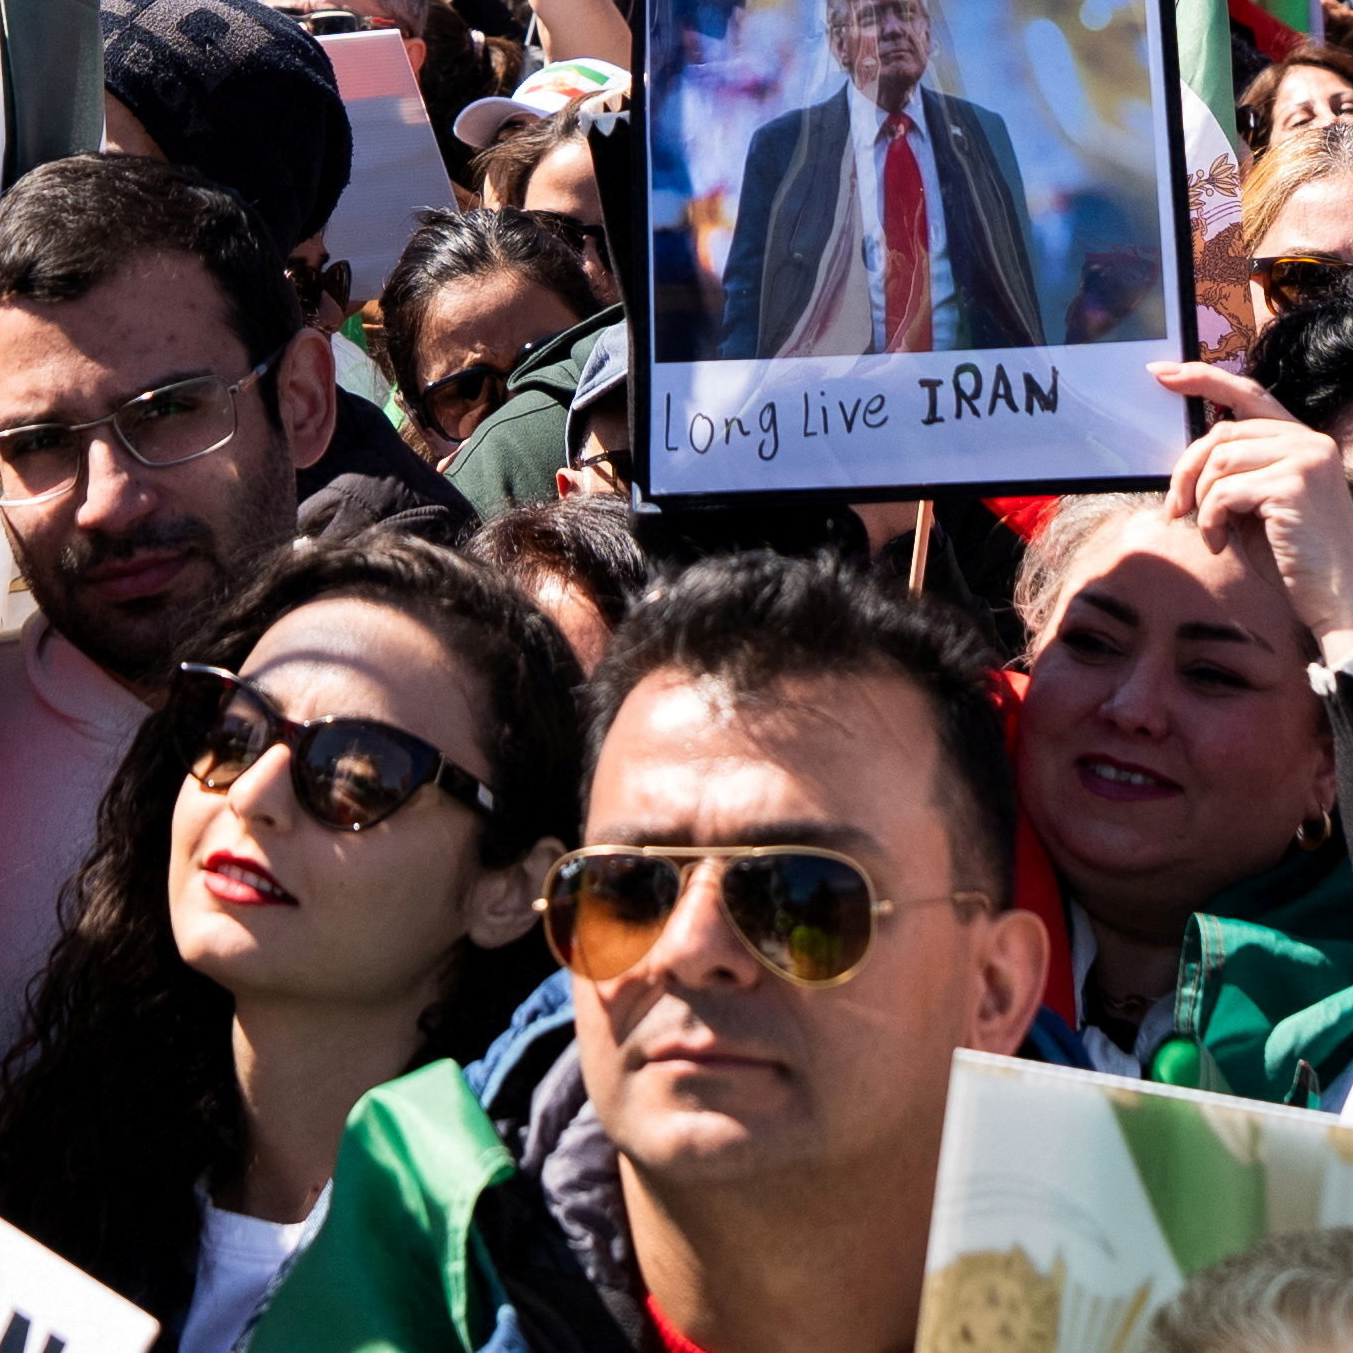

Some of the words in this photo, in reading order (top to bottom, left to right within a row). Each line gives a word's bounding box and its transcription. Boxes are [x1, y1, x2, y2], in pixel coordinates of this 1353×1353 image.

[664, 392, 779, 461] Long
[803, 390, 888, 438] Live
[919, 362, 1059, 426] IRAN
